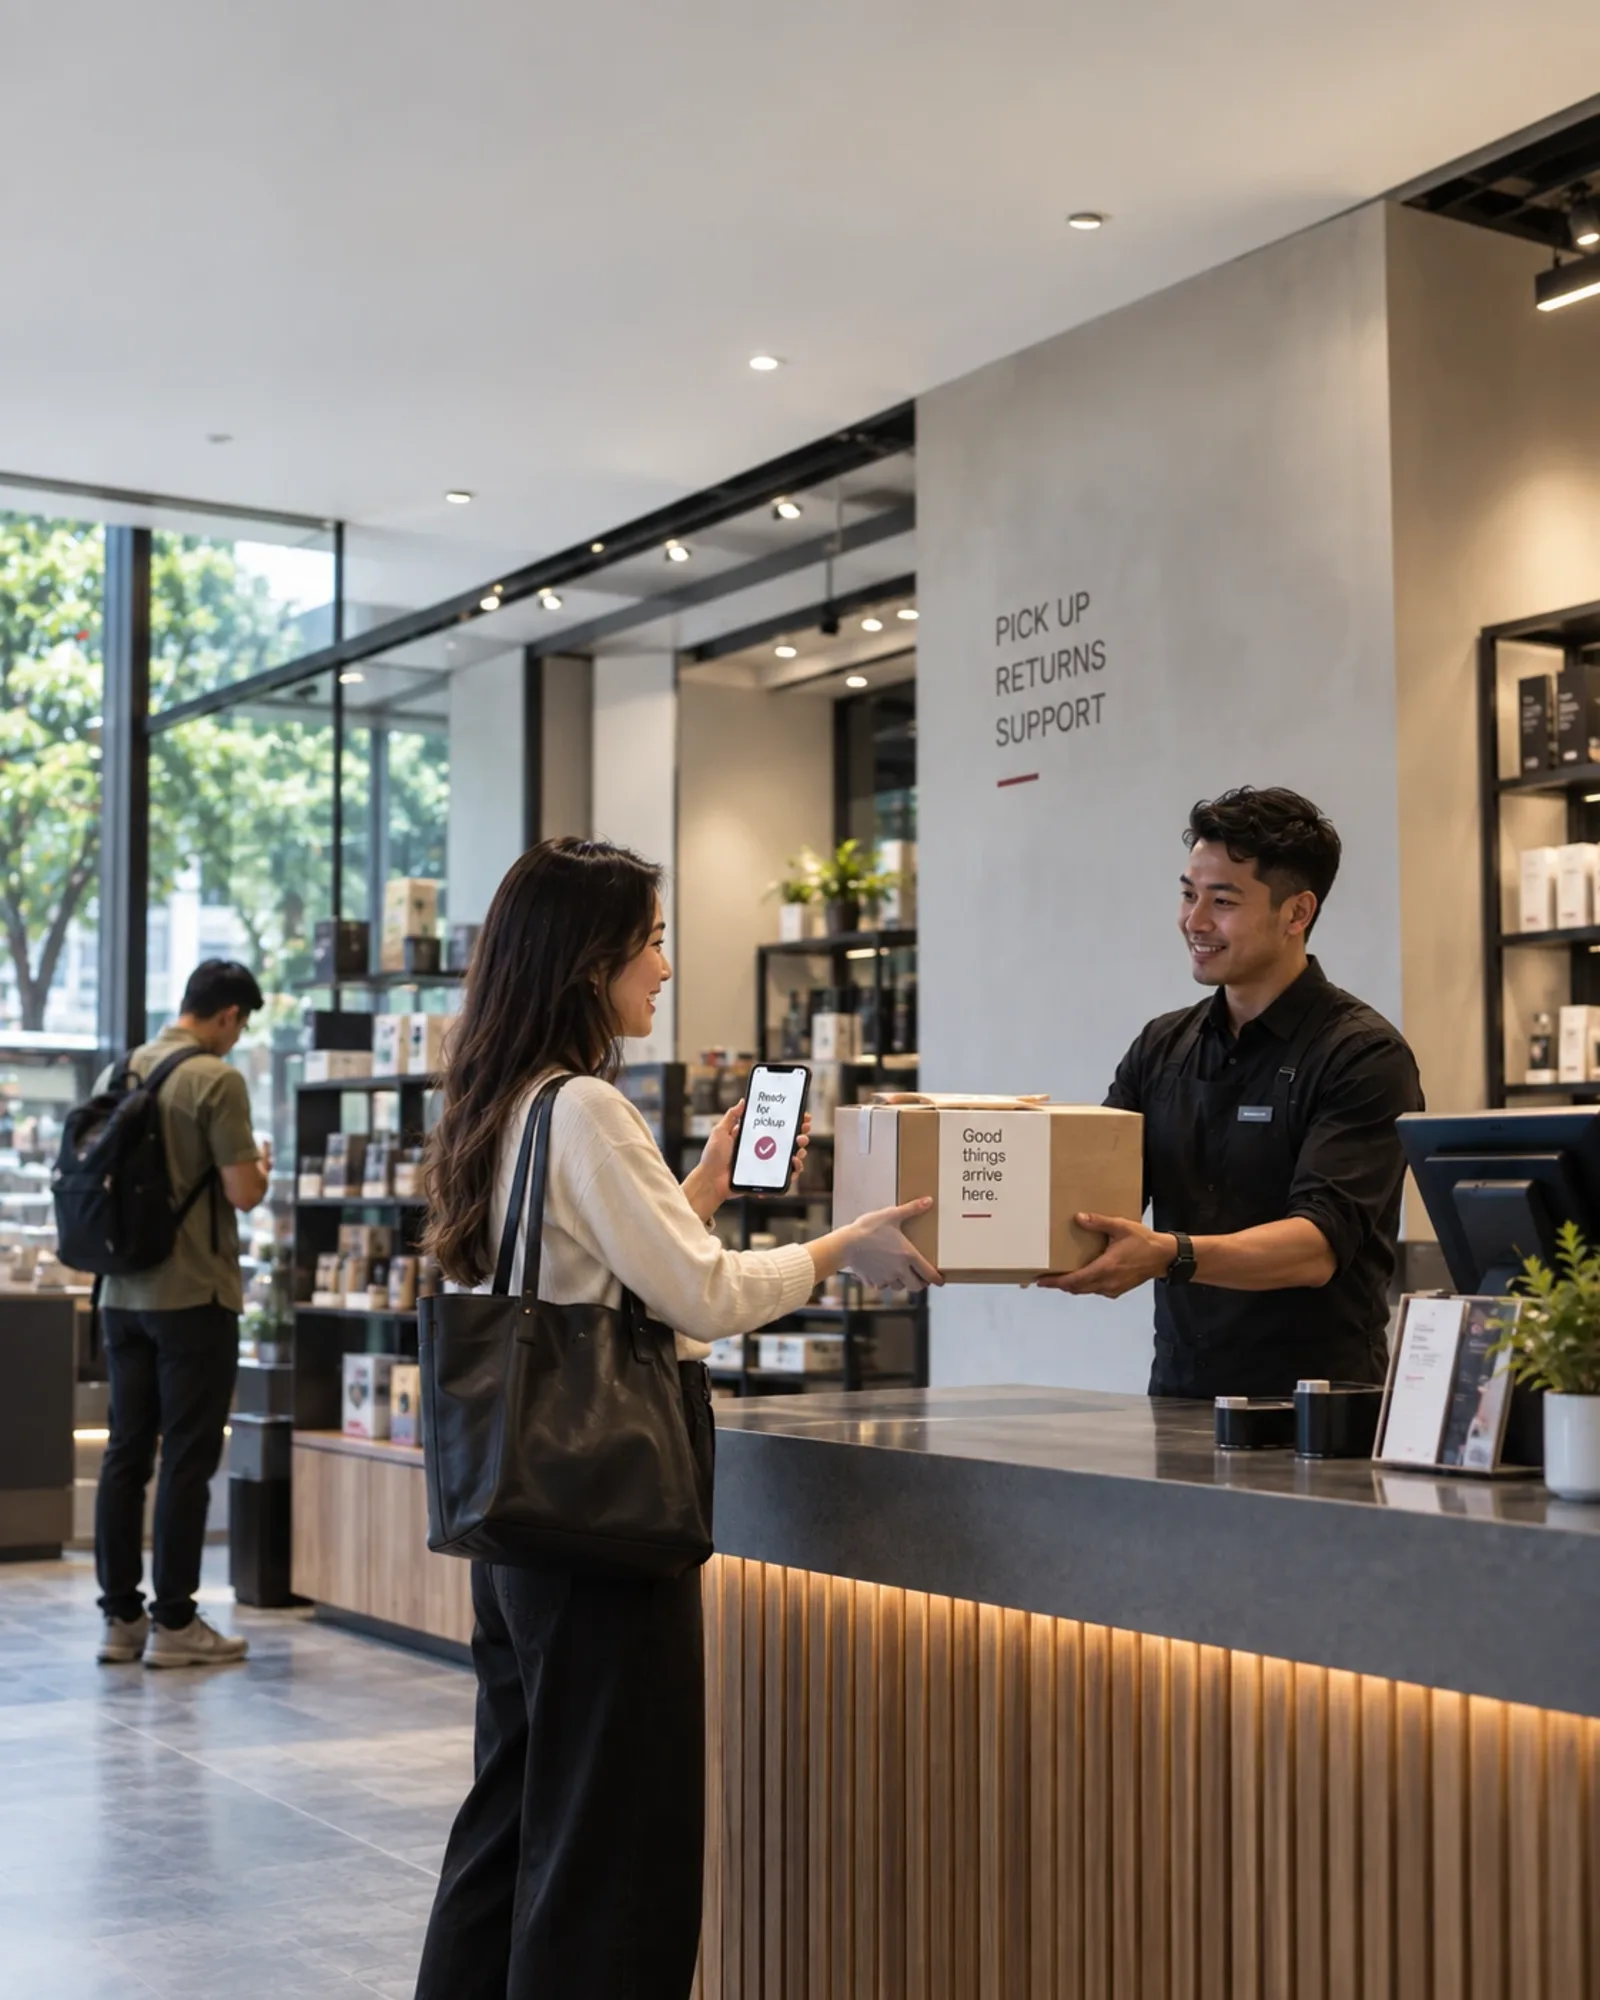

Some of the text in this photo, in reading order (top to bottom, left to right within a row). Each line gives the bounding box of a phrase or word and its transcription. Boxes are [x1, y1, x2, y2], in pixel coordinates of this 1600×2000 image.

[996, 591, 1090, 646] PICK UP
[996, 639, 1107, 697] RETURNS
[995, 692, 1106, 747] SUPPORT
[757, 1091, 787, 1105] Ready
[756, 1103, 770, 1115] for
[752, 1117, 786, 1130] pickup
[962, 1127, 1002, 1143] Good
[962, 1147, 1006, 1166] things
[962, 1167, 1003, 1182] arrive
[962, 1186, 998, 1201] here.
